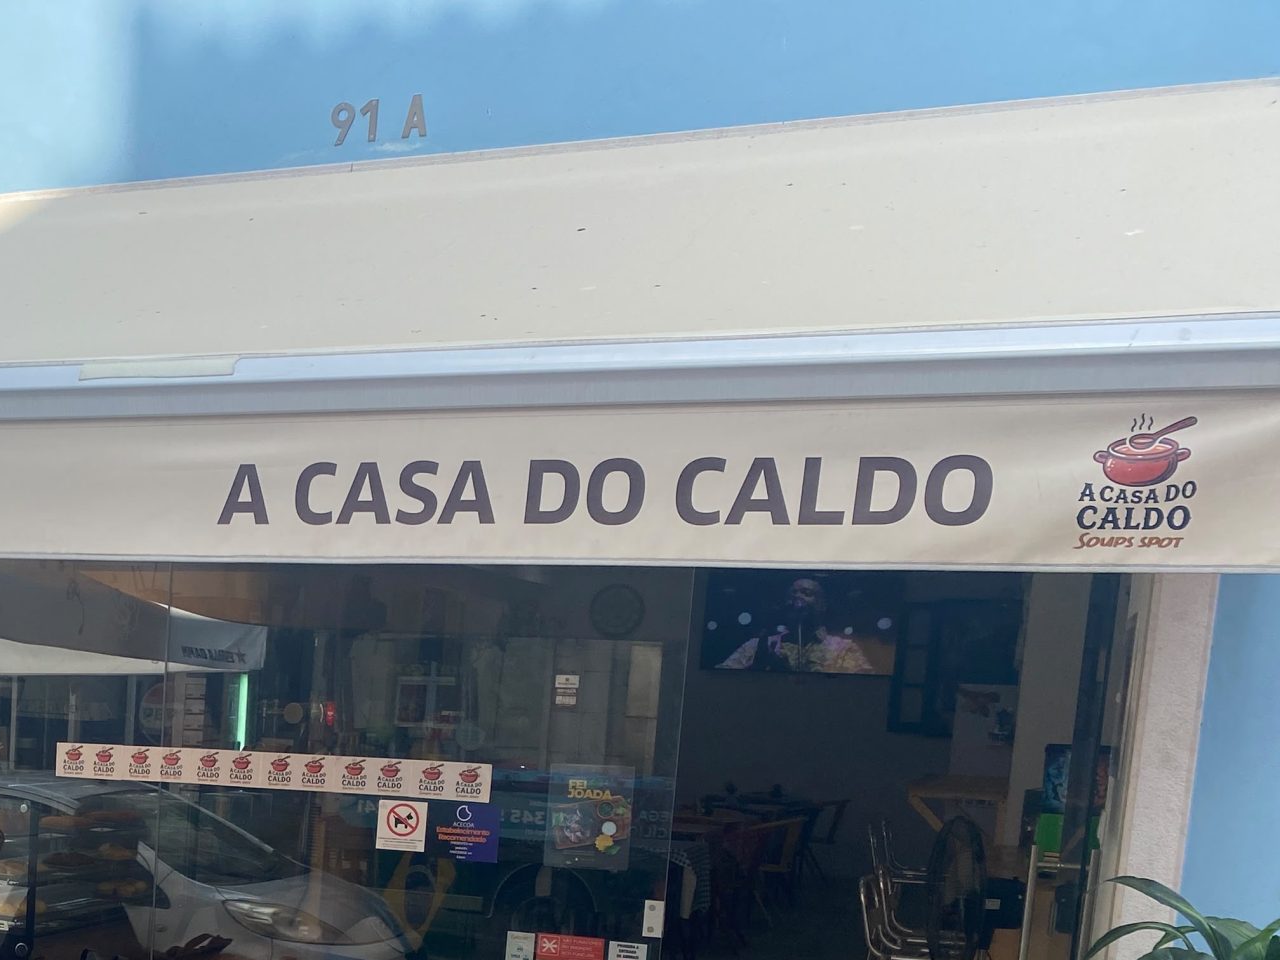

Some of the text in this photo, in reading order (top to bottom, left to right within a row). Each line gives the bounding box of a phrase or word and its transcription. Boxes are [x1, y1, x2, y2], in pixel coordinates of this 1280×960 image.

[331, 93, 427, 147] 91 A
[217, 455, 992, 526] A CASA DO CALDO
[1078, 481, 1197, 504] A CASA DO
[1076, 505, 1192, 531] CALDO
[419, 784, 444, 792] CALDO
[455, 787, 481, 795] CALDO
[567, 788, 612, 800] JOADA
